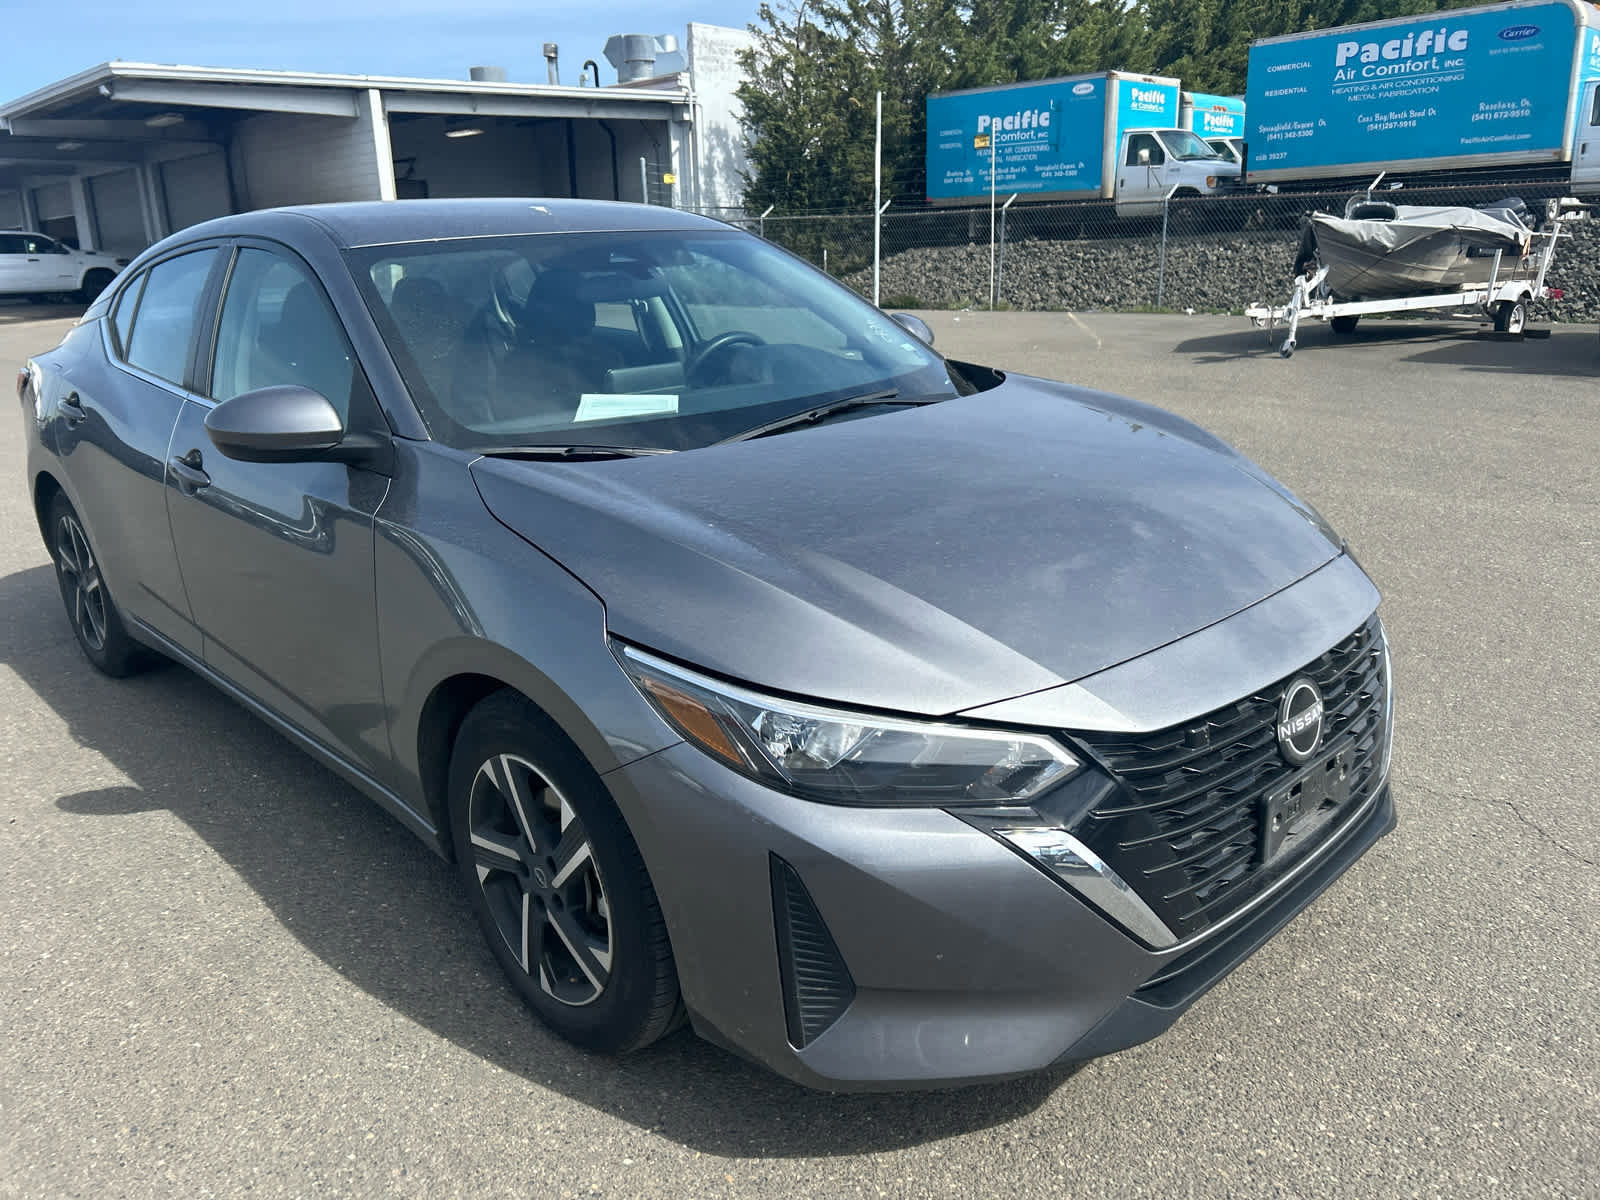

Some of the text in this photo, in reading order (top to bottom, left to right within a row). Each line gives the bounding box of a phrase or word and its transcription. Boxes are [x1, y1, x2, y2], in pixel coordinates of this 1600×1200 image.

[1503, 27, 1537, 38] Carrier
[1335, 28, 1469, 67] Pacific
[1267, 61, 1312, 73] COMMERCIAL
[1334, 68, 1357, 81] Air
[1361, 56, 1440, 78] Comfort,
[1264, 87, 1308, 97] RESIDENTIAL
[1331, 74, 1465, 96] HEATING & AIR CONDITIONING
[1347, 85, 1440, 102] METAL FABRICATION
[1131, 88, 1166, 105] Pacific
[978, 109, 1050, 133] Pacific
[1471, 112, 1493, 123] (541)
[1280, 702, 1324, 739] NISSAN
